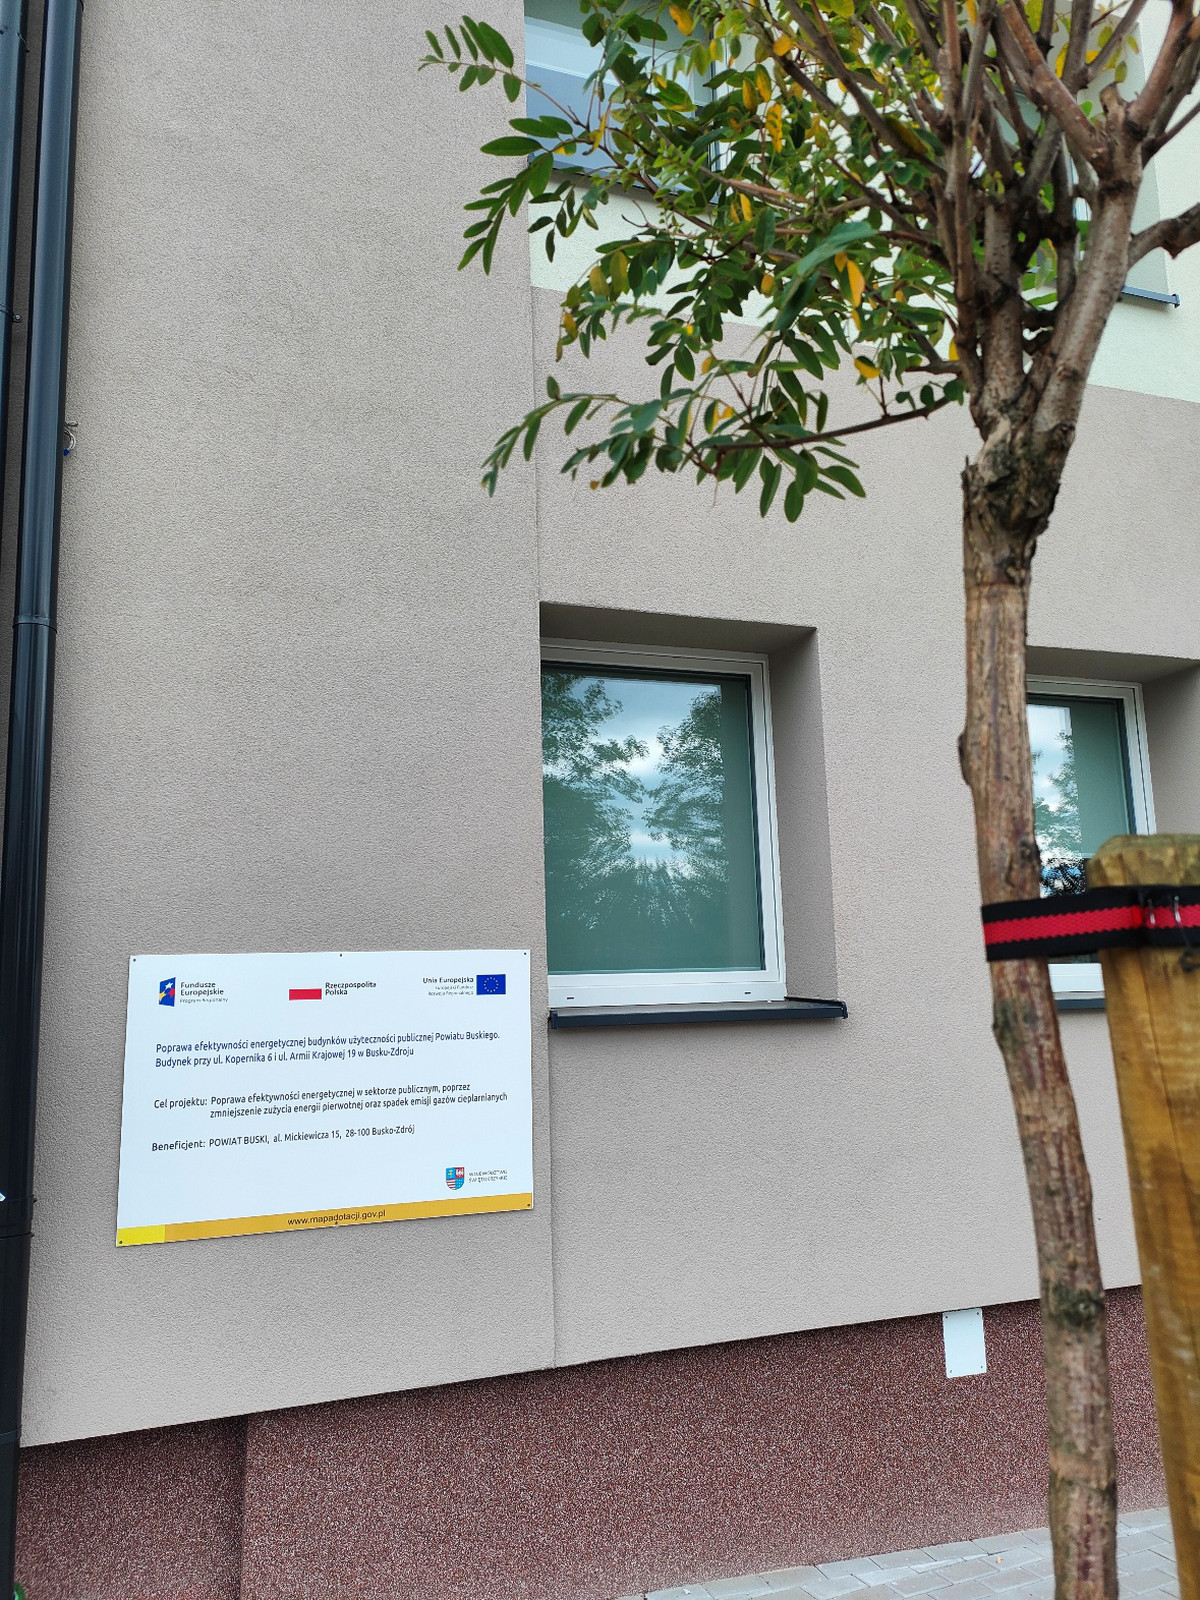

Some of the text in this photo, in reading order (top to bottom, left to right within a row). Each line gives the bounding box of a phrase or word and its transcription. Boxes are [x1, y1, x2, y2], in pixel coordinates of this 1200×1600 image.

[325, 981, 377, 989] Rzeczpospolita
[439, 976, 474, 984] Europejska
[181, 988, 224, 996] Europejskie
[156, 1031, 500, 1054] Poprawa efektywności energetycznej budynków użyteczności publicznej Powiatu Buskiego.
[156, 1057, 192, 1068] Budynek
[194, 1058, 211, 1067] przy
[213, 1055, 223, 1064] ul.
[225, 1054, 265, 1065] Kopernika
[268, 1053, 272, 1061] 6
[274, 1053, 276, 1061] i
[278, 1052, 287, 1061] ul.
[290, 1051, 310, 1060] Armii
[312, 1050, 345, 1061] Krajowej
[348, 1049, 356, 1058] 19
[366, 1047, 414, 1057] Busku-Zdroju
[154, 1099, 168, 1108] Cel
[170, 1098, 208, 1109] projektu:
[211, 1097, 246, 1106] Poprawa
[248, 1091, 300, 1103] efektywności
[301, 1089, 355, 1100] energetycznej
[365, 1087, 396, 1096] sektorze
[398, 1085, 440, 1095] publicznym,
[442, 1084, 470, 1093] poprzez
[210, 1092, 507, 1118] zmniejszenie zużycia energii pierwotnej oraz spadek emisji gazów cieplarnianych
[152, 1124, 415, 1151] Beneficjent: POWIAT BUSKI, al. Mickiewicza 15, 28-100 Busko-Zdrój
[288, 1209, 386, 1225] www.mapadotacji.gov.pl
